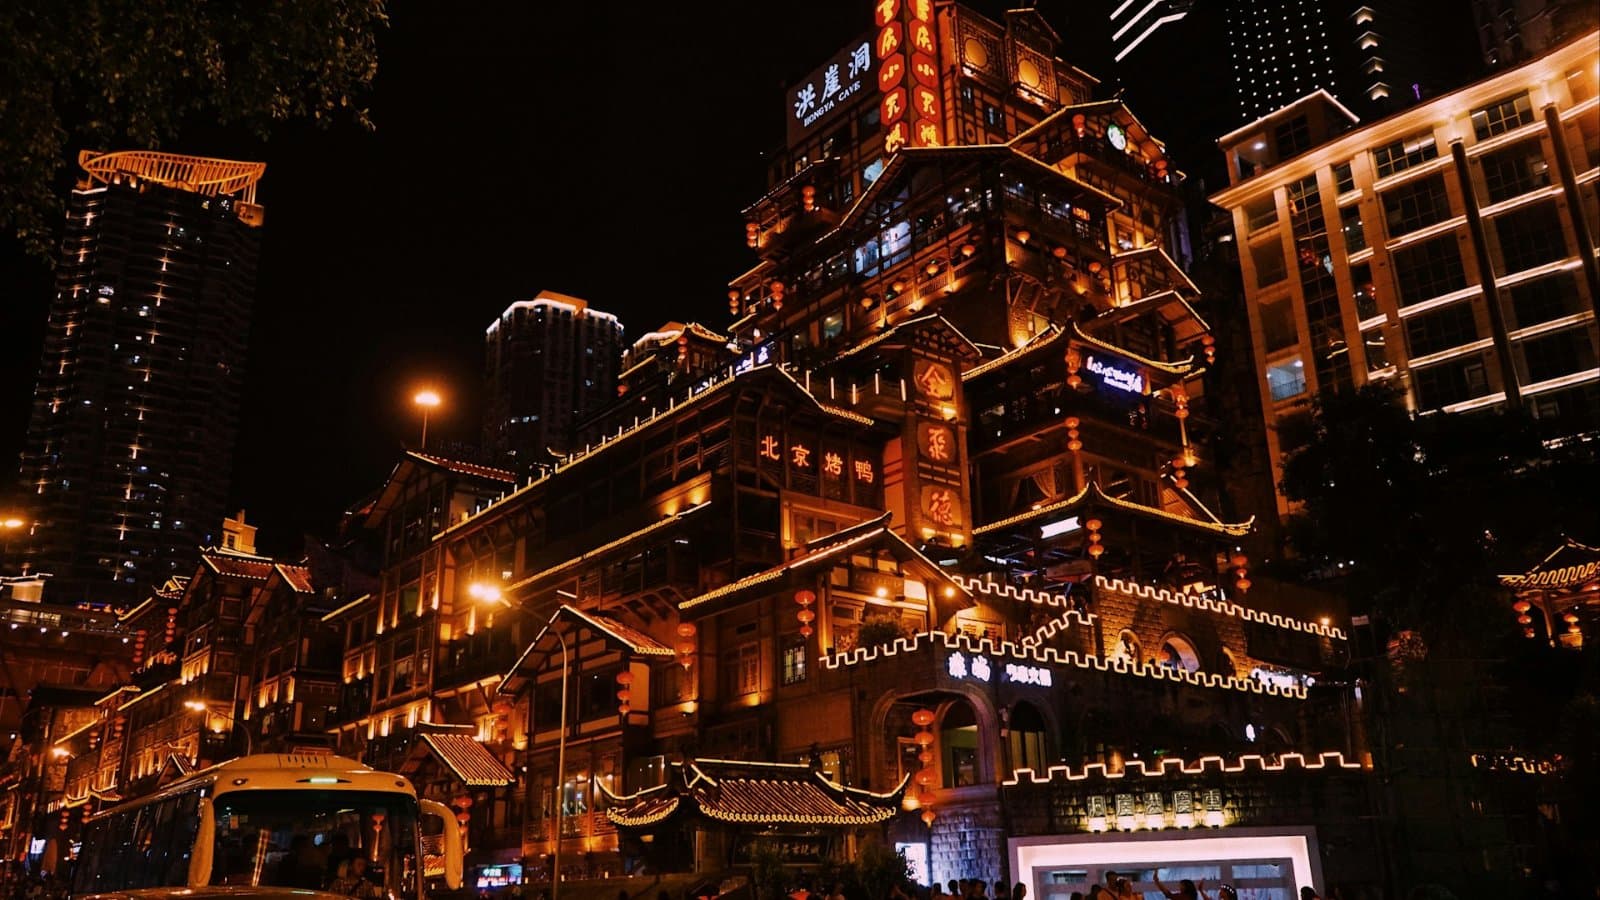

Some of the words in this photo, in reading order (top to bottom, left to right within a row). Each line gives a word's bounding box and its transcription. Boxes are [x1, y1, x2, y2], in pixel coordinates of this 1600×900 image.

[794, 41, 871, 119] 洪崖洞
[803, 100, 835, 127] HONGYA
[838, 80, 861, 101] CAVE
[760, 435, 874, 483] 北京烤鸭
